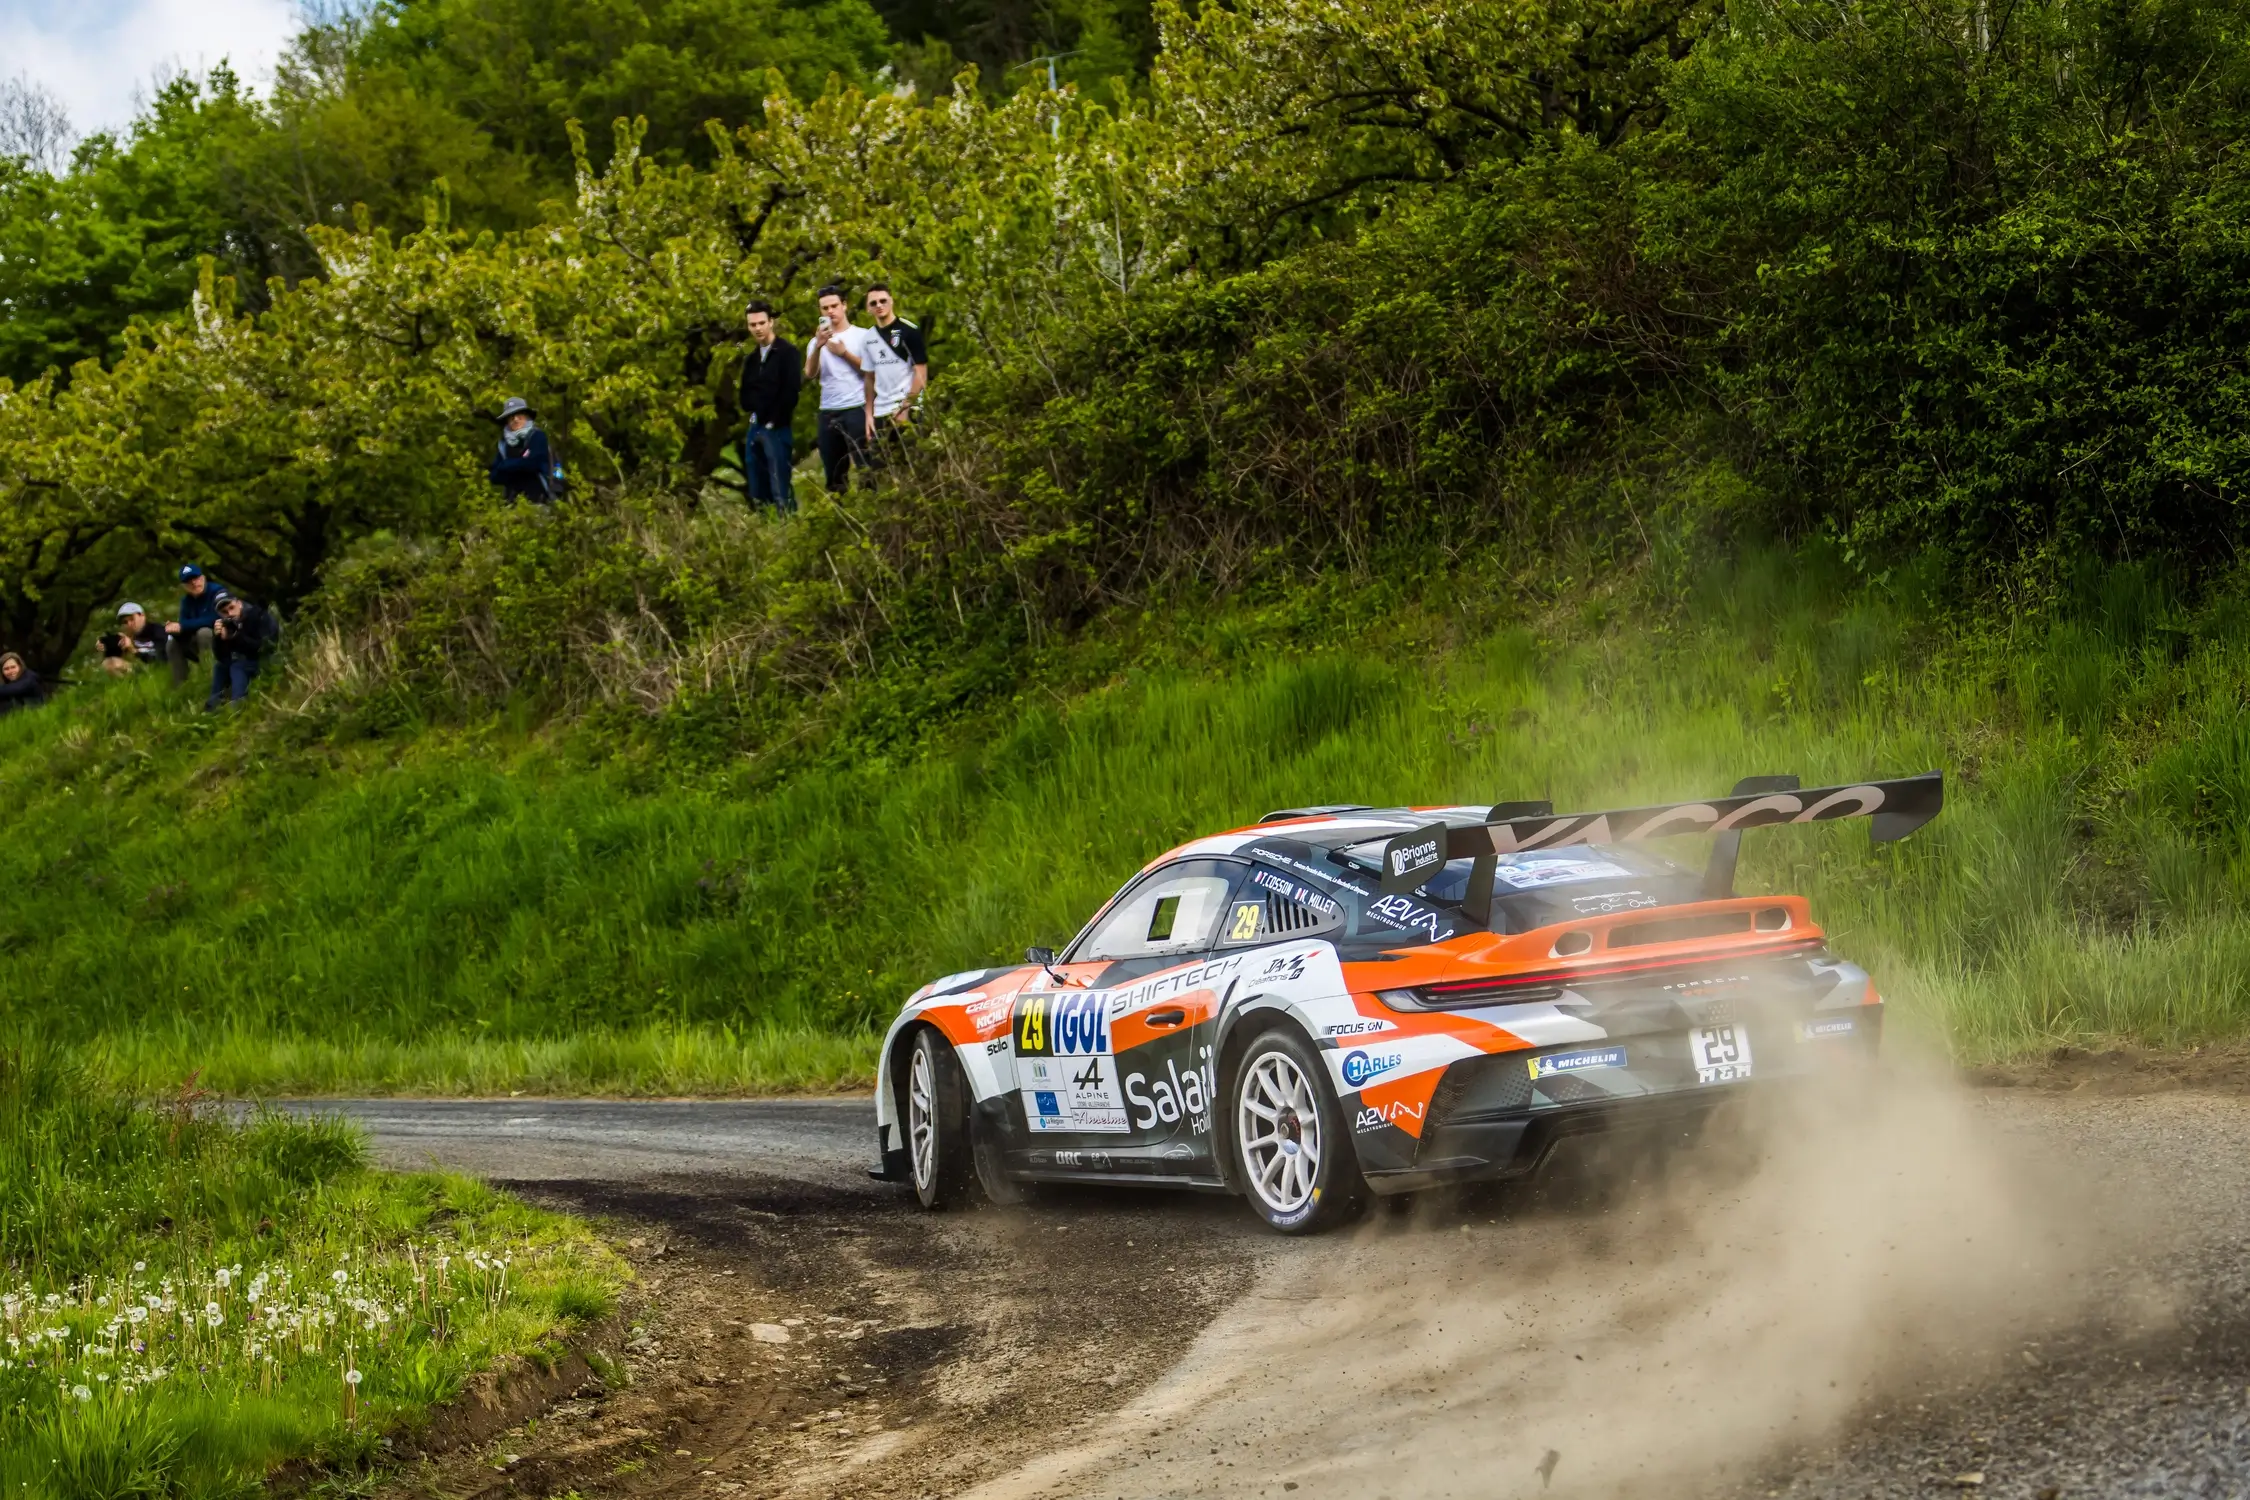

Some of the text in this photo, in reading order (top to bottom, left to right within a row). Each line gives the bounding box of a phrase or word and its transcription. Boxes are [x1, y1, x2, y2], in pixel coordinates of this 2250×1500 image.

[1251, 847, 1293, 865] PORSCHE
[1401, 840, 1437, 862] Brionne
[1308, 896, 1336, 915] MILLET
[1231, 904, 1260, 940] 29
[1111, 956, 1243, 1015] SHIFTECH
[1662, 975, 1750, 993] PORSCHE
[1021, 993, 1109, 1054] 29 IGOL
[1329, 1021, 1383, 1035] FOCUS ON
[1815, 1022, 1853, 1033] MICHELIN
[987, 1037, 1008, 1057] Stilo
[1700, 1024, 1740, 1065] 29
[1557, 1053, 1618, 1069] MICHELIN
